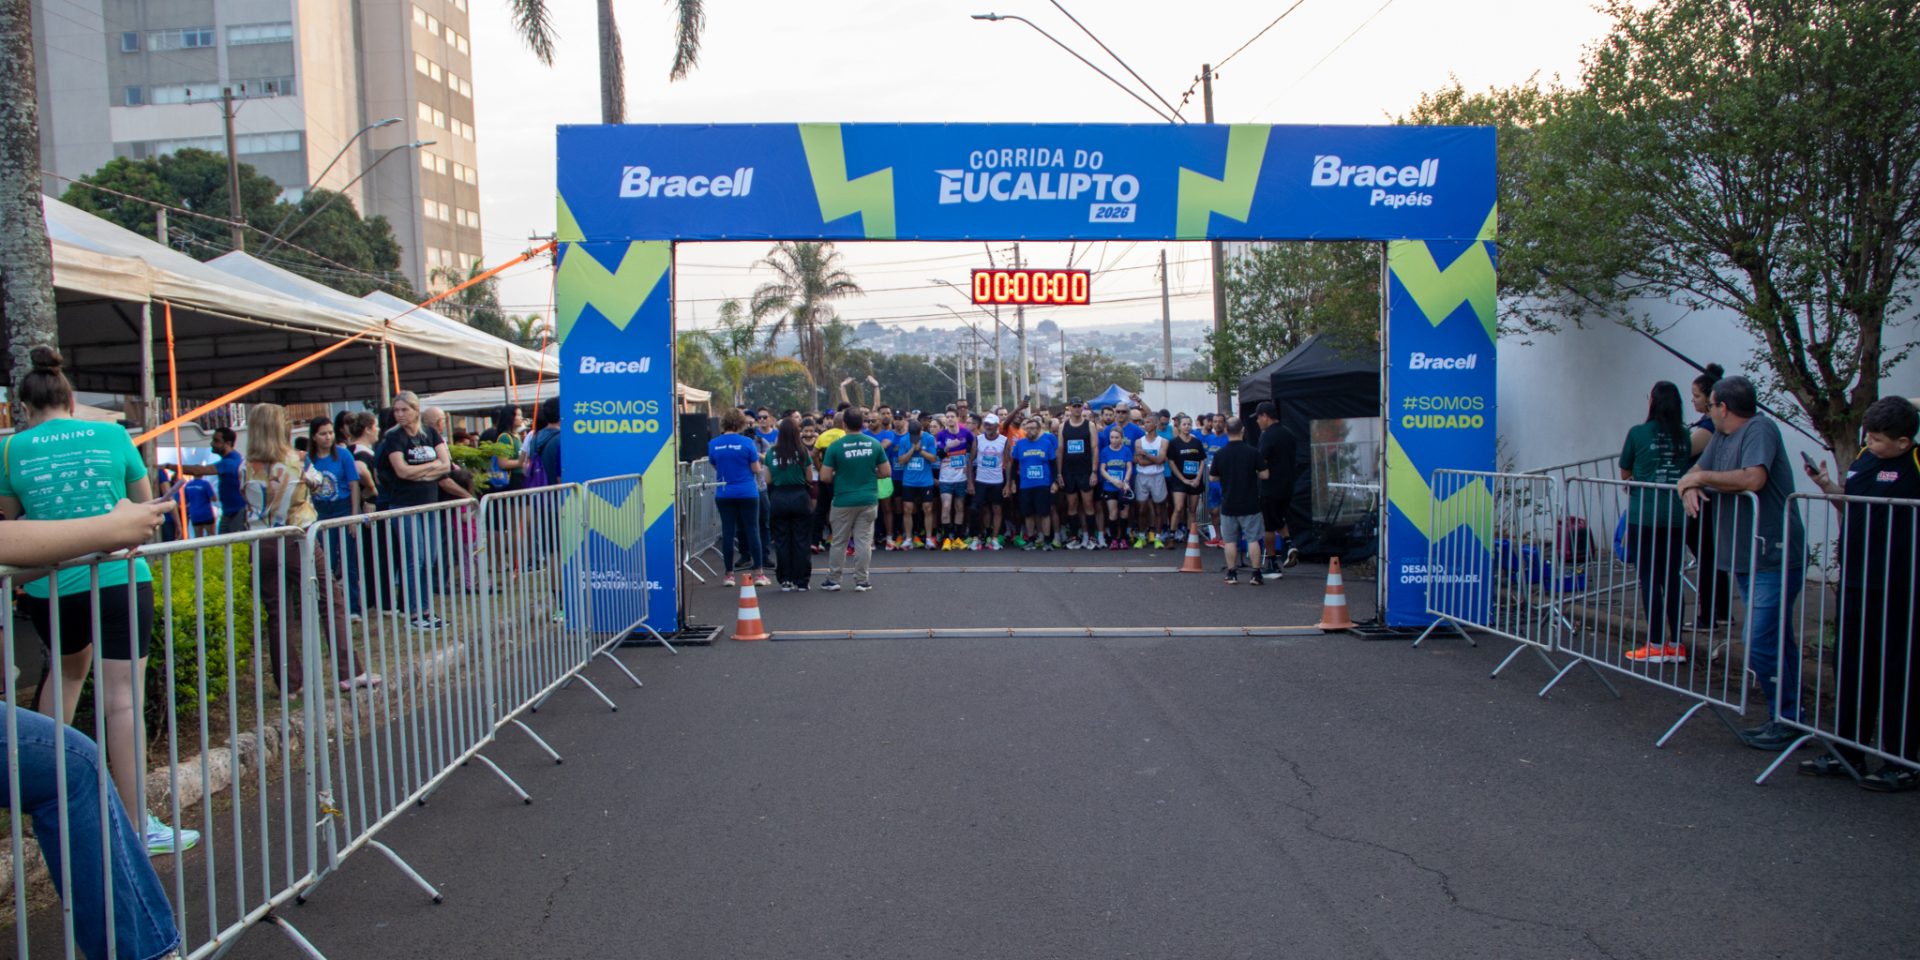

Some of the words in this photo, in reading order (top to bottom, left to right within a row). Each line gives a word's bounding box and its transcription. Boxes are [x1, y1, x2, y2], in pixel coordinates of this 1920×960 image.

[969, 148, 1065, 170] CORRIDA
[1074, 150, 1104, 170] DO
[1311, 154, 1438, 187] Bracell
[619, 165, 754, 198] Bracell
[934, 169, 1140, 205] EUCALIPTO
[1370, 189, 1433, 209] Papéis
[1095, 206, 1130, 219] 2026
[974, 272, 1088, 302] 00:00:00
[579, 356, 650, 374] Bracell
[1409, 352, 1477, 370] Bracell
[573, 400, 659, 415] #SOMOS
[1402, 396, 1484, 411] #SOMOS
[573, 418, 659, 434] CUIDADO
[1402, 414, 1484, 429] CUIDADO
[31, 429, 96, 444] RUNNING
[844, 448, 873, 458] STAFF
[1401, 564, 1446, 574] DESAIO,
